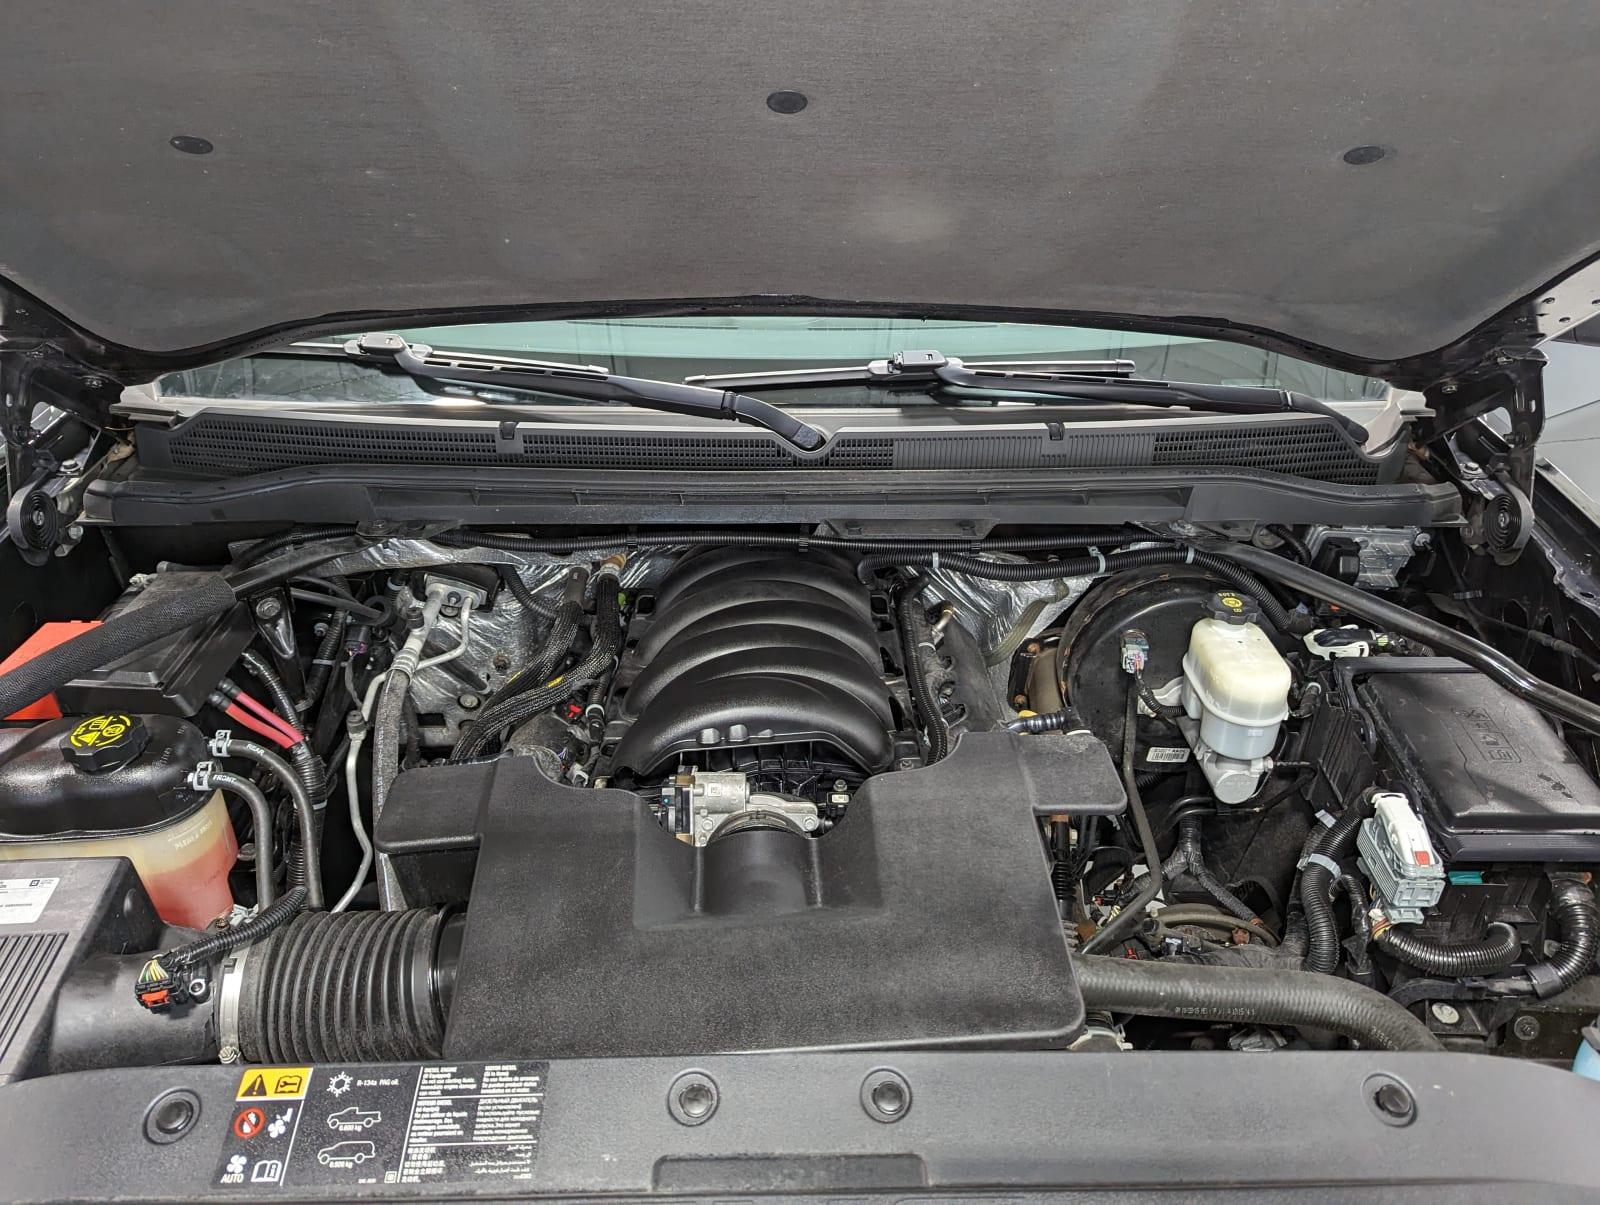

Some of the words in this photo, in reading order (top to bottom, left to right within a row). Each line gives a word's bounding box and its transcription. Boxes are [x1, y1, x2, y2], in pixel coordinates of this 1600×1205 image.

[246, 743, 265, 756] REAR
[213, 774, 237, 783] FRONT
[220, 1173, 244, 1183] AUTO
